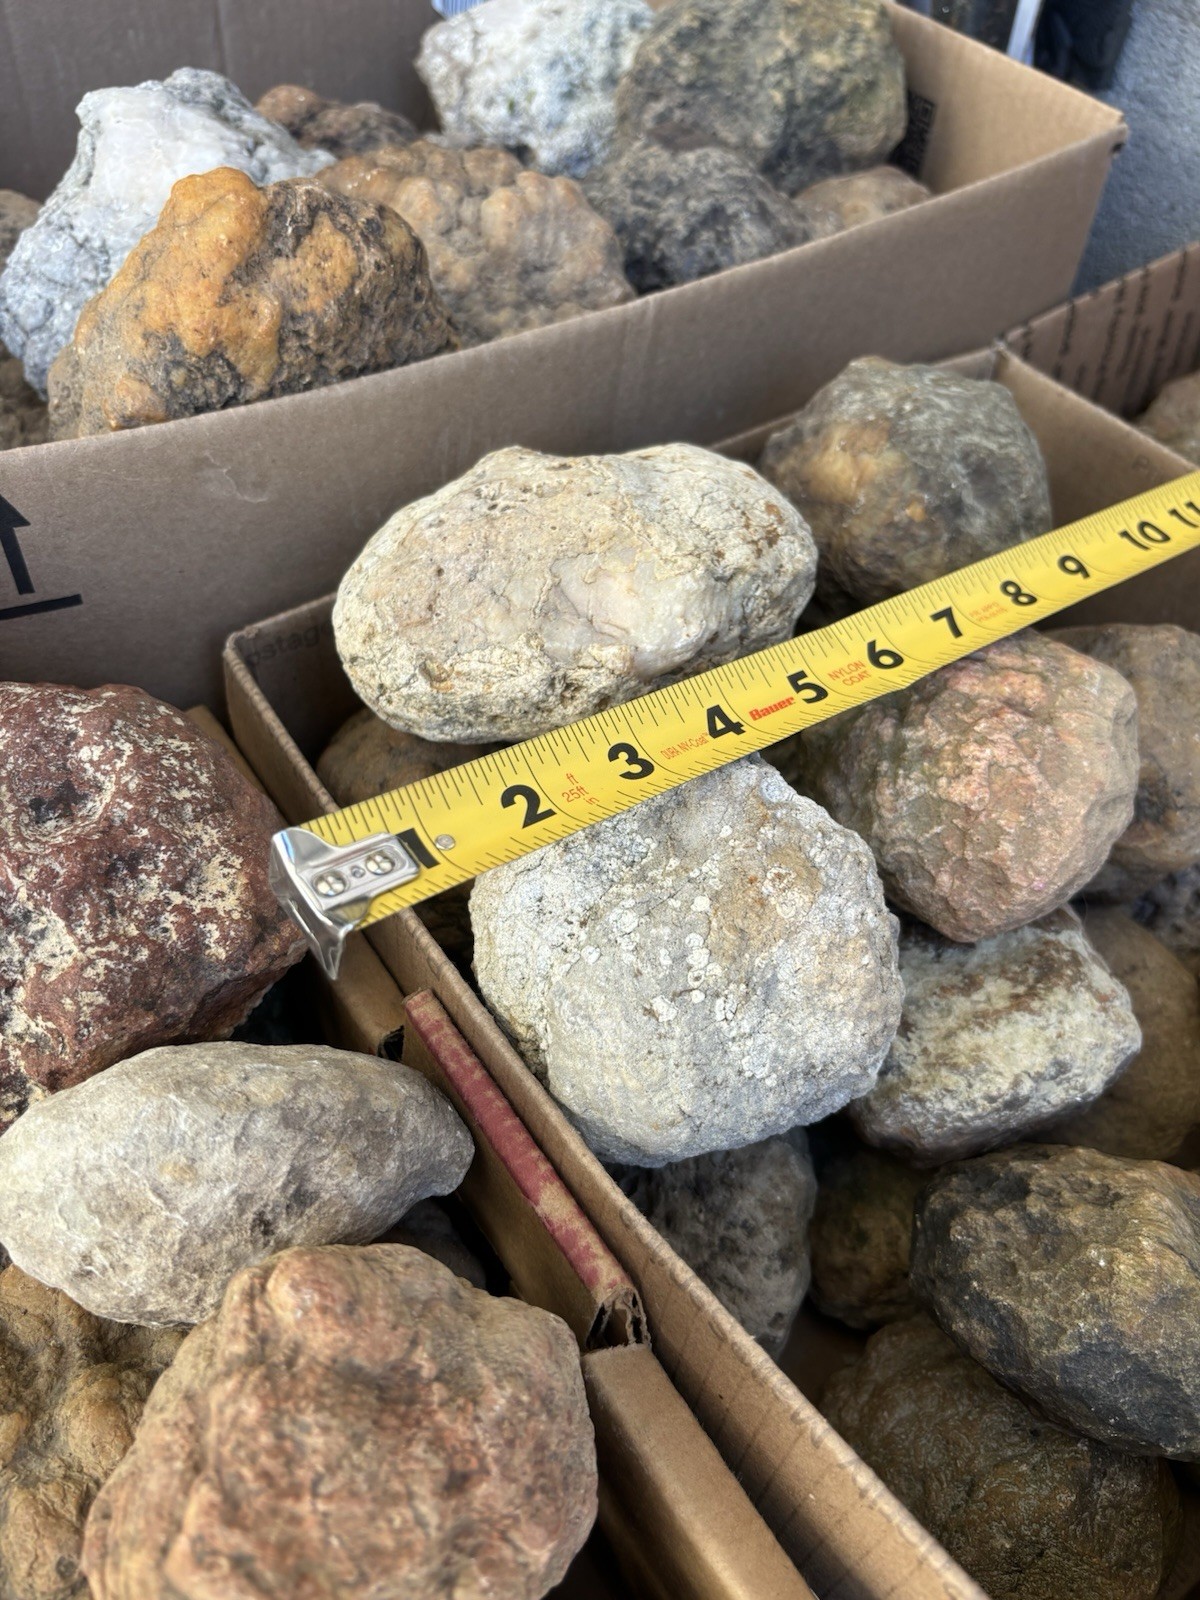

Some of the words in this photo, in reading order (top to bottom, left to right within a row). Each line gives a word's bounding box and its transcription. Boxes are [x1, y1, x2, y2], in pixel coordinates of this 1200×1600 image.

[1168, 501, 1200, 528] 11
[1118, 521, 1171, 550] 10
[1057, 555, 1090, 579] 9
[1001, 581, 1037, 606] 8
[930, 607, 963, 639] 7
[867, 640, 904, 670] 6
[827, 660, 866, 681] NYLON
[841, 672, 872, 688] COAT
[787, 670, 828, 704] 5
[706, 704, 746, 739] 4
[749, 697, 794, 721] Bauer
[607, 743, 656, 779] 3
[565, 773, 579, 785] ft
[501, 784, 557, 829] 2
[561, 786, 589, 803] 25ft
[585, 796, 600, 805] in
[395, 827, 441, 869] 1
